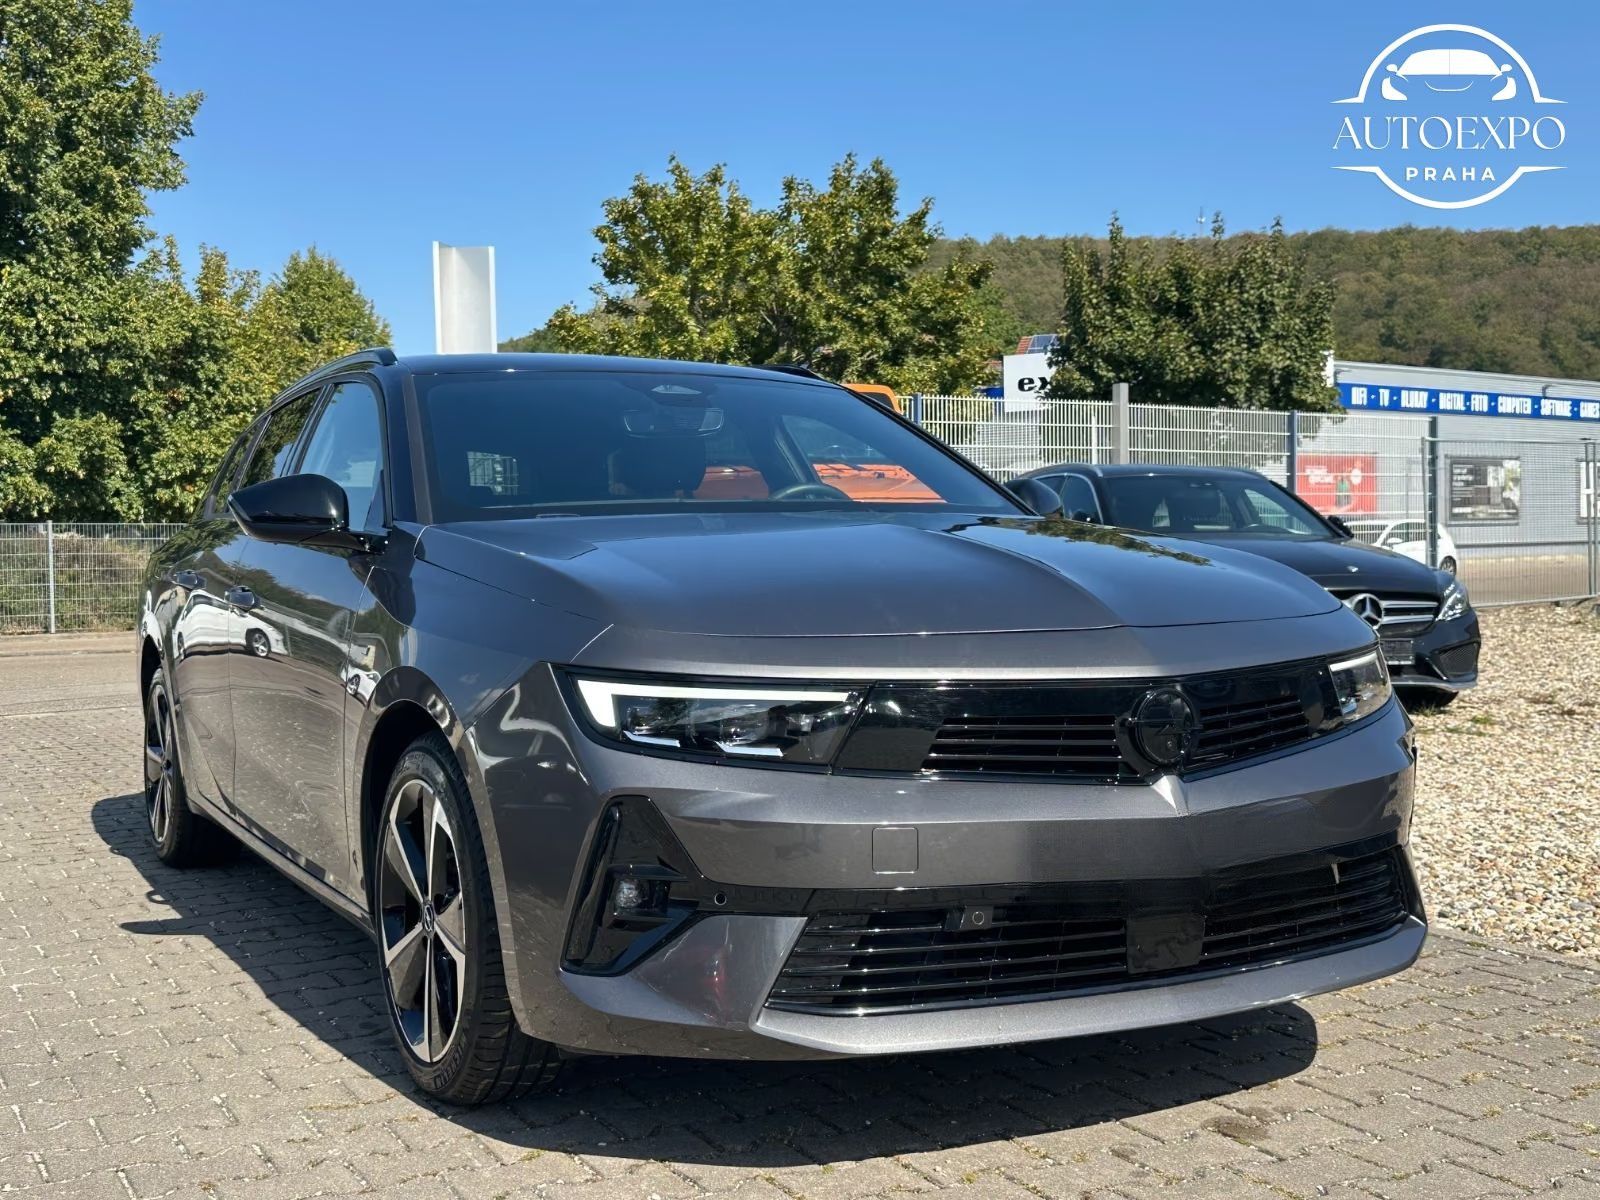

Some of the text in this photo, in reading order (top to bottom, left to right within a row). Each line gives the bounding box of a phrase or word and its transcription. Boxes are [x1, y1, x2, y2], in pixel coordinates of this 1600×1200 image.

[1378, 388, 1390, 407] TV
[1439, 392, 1466, 411] DIGITAL
[1471, 394, 1488, 413] FOTO
[1497, 396, 1532, 415] COMPUTER
